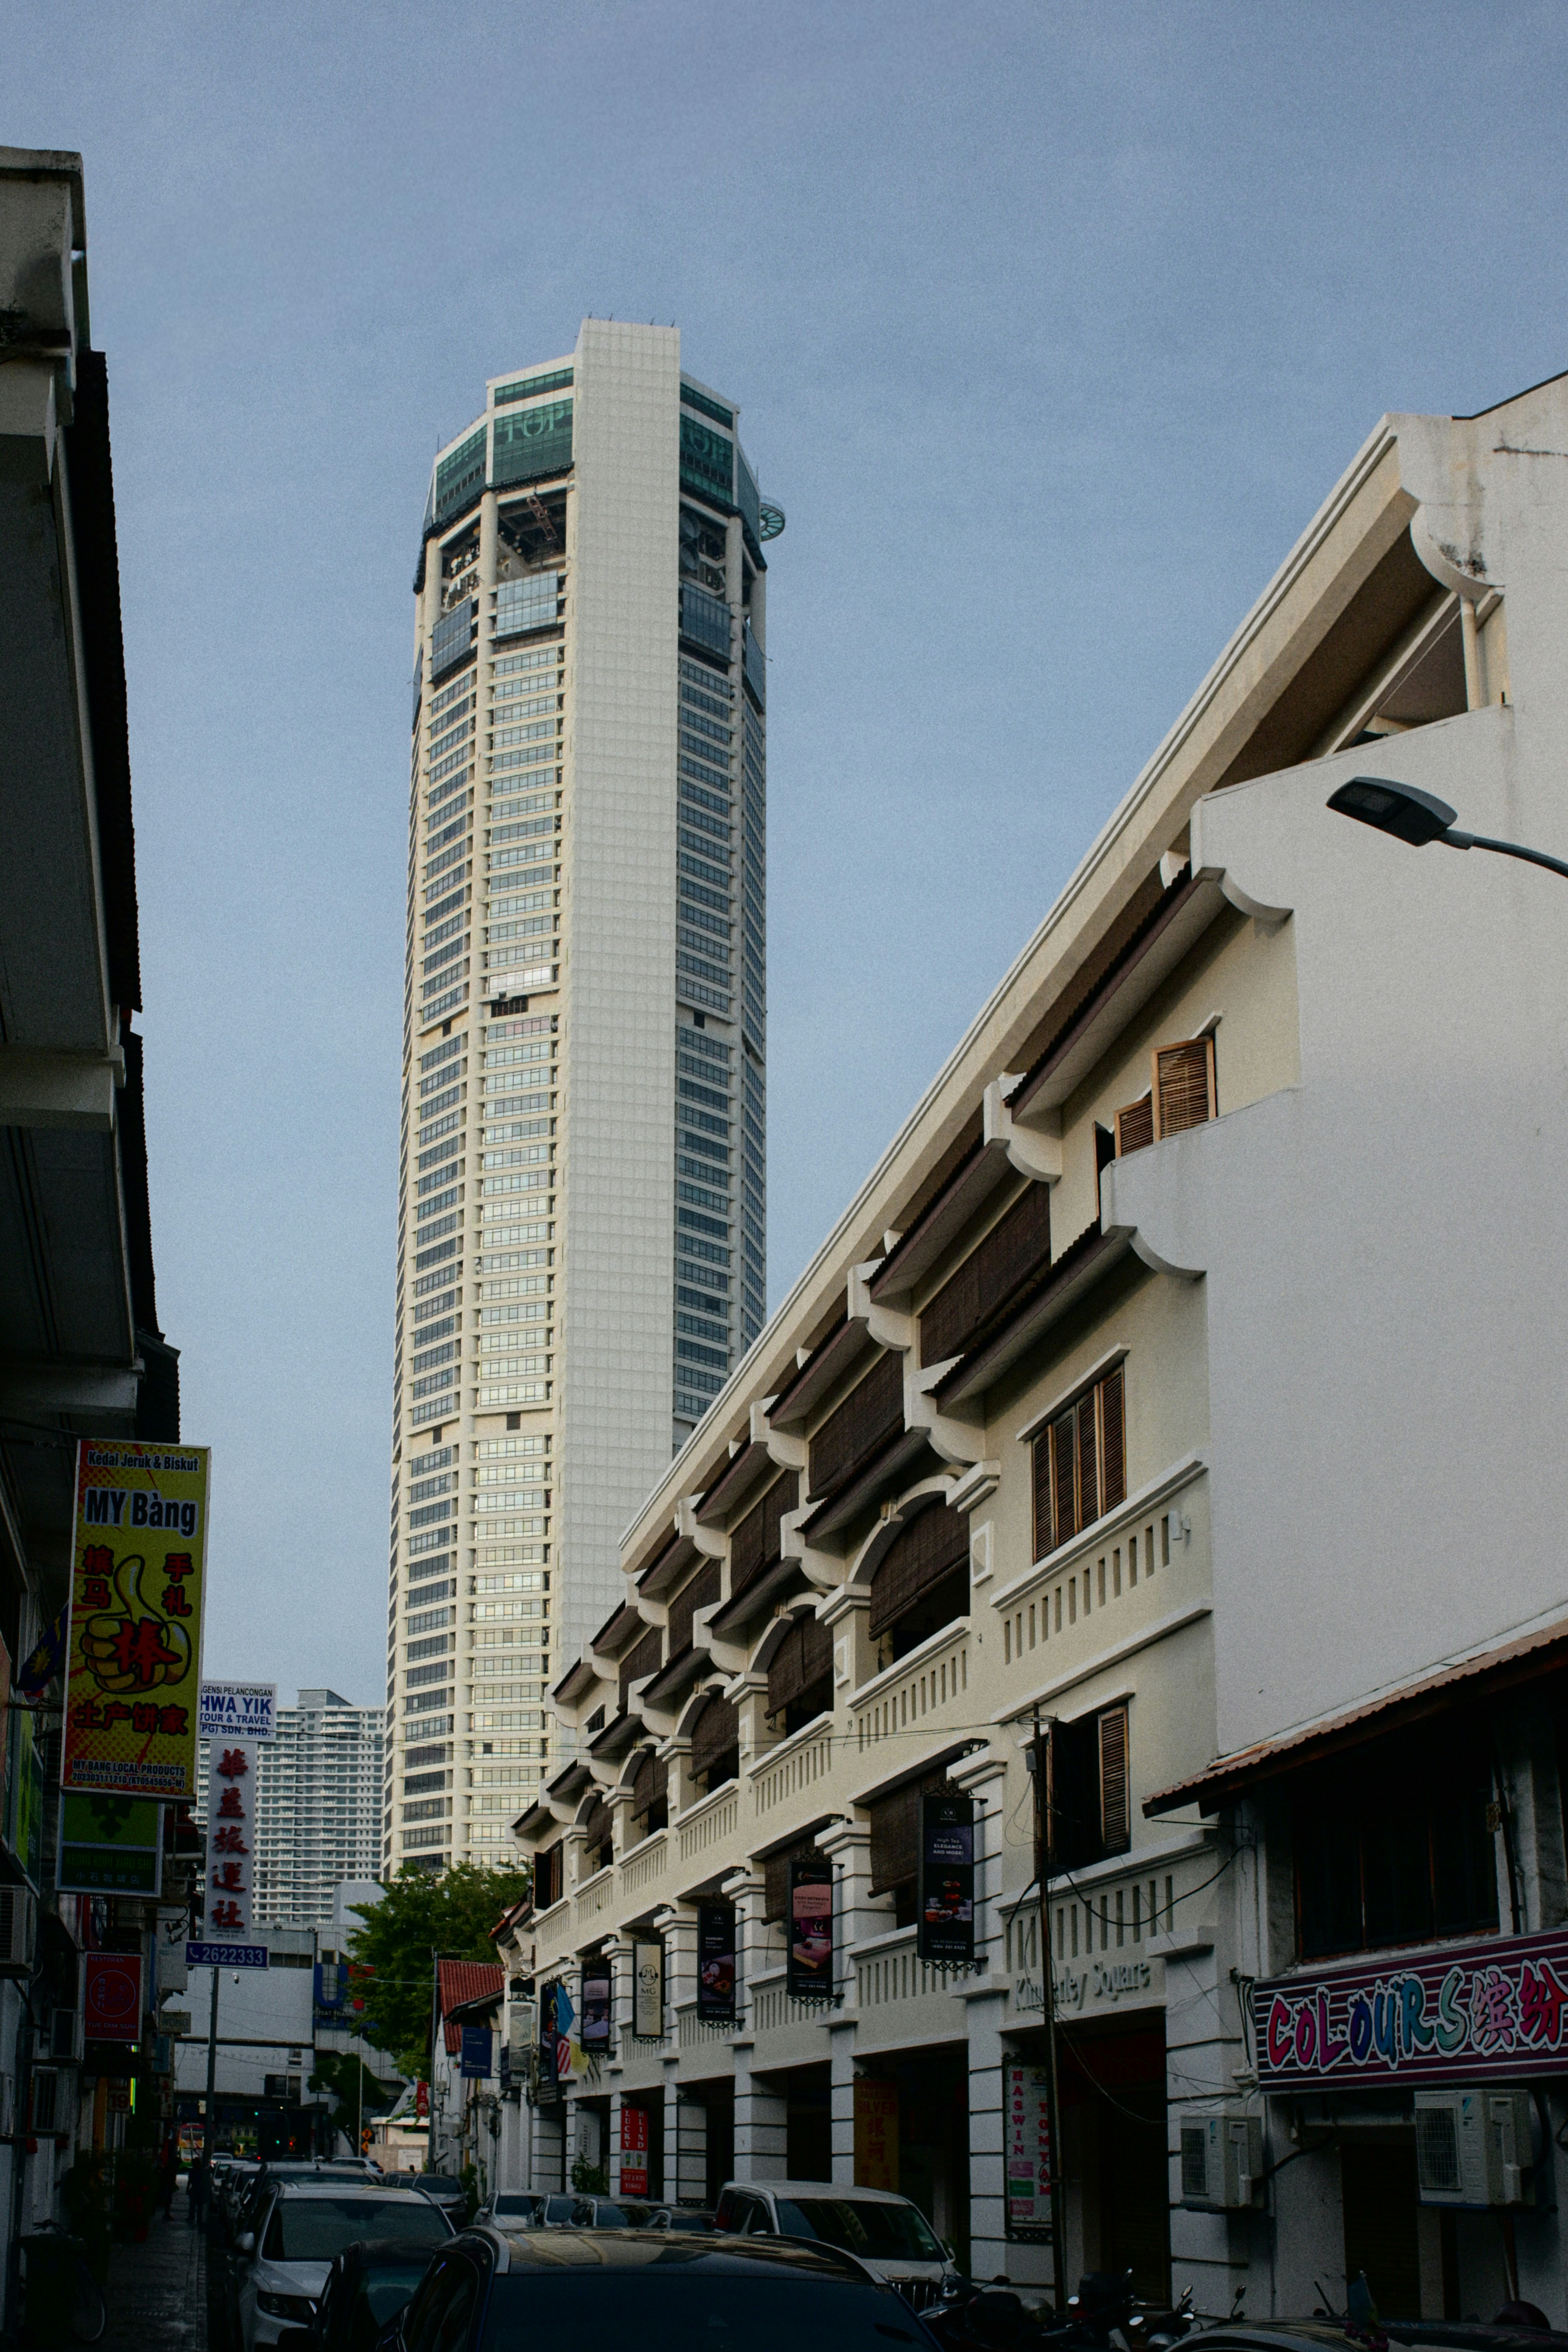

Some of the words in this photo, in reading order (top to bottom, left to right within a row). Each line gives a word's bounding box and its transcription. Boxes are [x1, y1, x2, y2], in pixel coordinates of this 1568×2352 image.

[88, 1451, 118, 1466] Kedai
[121, 1454, 151, 1468] Jeruk
[153, 1456, 161, 1469] &
[164, 1457, 198, 1472] Biskut
[86, 1489, 126, 1524] MY
[131, 1493, 196, 1536] Bàng
[161, 1553, 194, 1617] 手礼
[107, 1616, 183, 1685] 棒
[202, 1685, 222, 1694] GENSI
[224, 1687, 272, 1697] PELANCONGAN
[201, 1695, 237, 1713] HWA
[242, 1697, 272, 1715] YIK
[74, 1700, 189, 1736] 土产饼家
[226, 1714, 233, 1723] &
[236, 1715, 271, 1725] TRAVEL
[221, 1725, 244, 1735] SDN.
[247, 1727, 270, 1736] BHD.
[73, 1759, 86, 1769] MY
[88, 1761, 111, 1772] BANG
[113, 1762, 139, 1773] LOCAL
[141, 1764, 185, 1776] PRODUCTS
[72, 1773, 127, 1785] 202303111210
[212, 1748, 249, 1928] 華益旅運社
[93, 1855, 113, 1867] KOPI
[137, 1858, 152, 1871] SHI
[202, 1946, 264, 1965] 2622333
[1094, 1961, 1150, 2001] Square
[1268, 1968, 1467, 2070] COLOURS
[110, 2093, 128, 2109] 19
[1012, 2071, 1025, 2155] HASWIN
